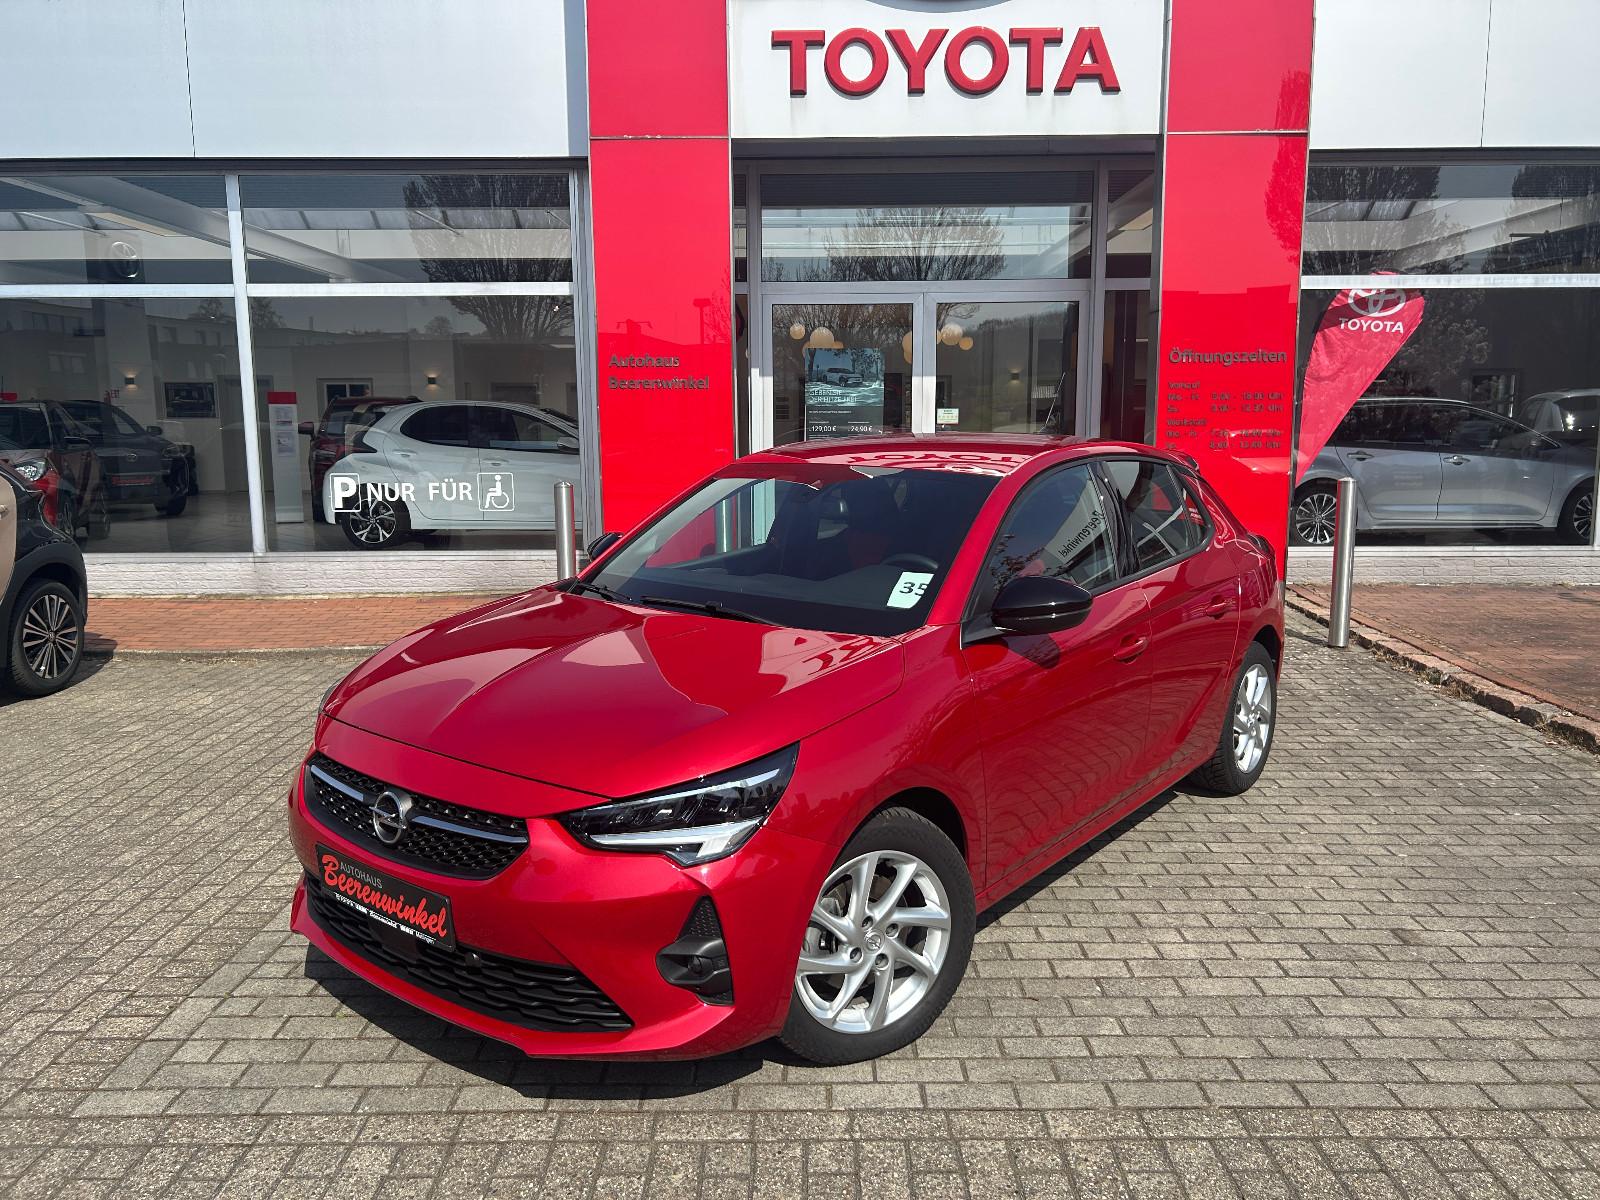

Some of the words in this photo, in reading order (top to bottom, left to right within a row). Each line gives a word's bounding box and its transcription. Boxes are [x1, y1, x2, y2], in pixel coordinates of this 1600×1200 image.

[771, 26, 1121, 97] TOYOTA
[1339, 317, 1404, 334] TOYOTA
[608, 353, 681, 368] Autohaus
[1168, 347, 1287, 366] Öffnungszeiten
[608, 375, 709, 390] Beerenwinkel
[811, 425, 832, 433] 129,00
[333, 476, 357, 509] P
[366, 482, 416, 502] NUR
[428, 478, 473, 502] FÜR
[340, 861, 383, 889] AUTOHAUS
[322, 854, 447, 938] Beerenwinkel
